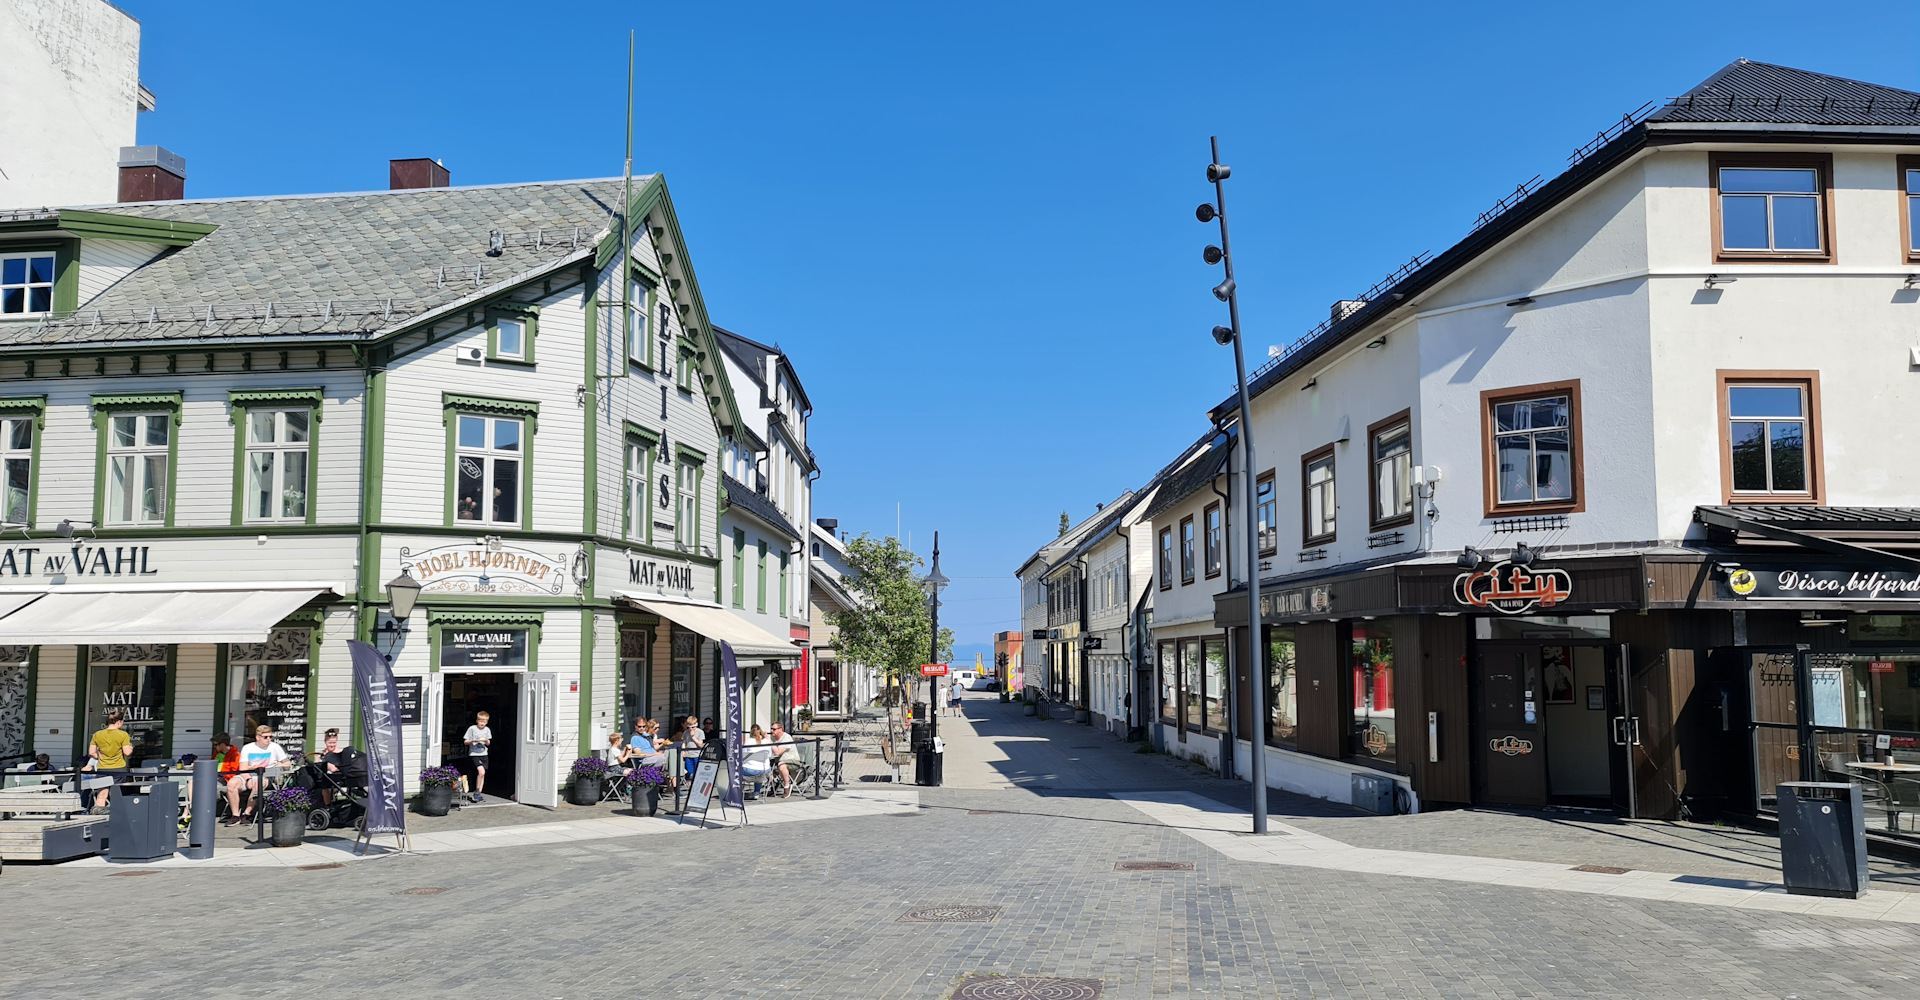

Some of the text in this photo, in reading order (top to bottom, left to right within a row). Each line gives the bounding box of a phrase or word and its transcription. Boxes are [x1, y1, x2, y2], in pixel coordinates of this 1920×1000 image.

[657, 302, 672, 511] ELIAS
[460, 458, 481, 478] OPEN
[43, 556, 66, 574] AV
[71, 546, 158, 576] VAHL
[415, 550, 551, 580] HOEL-HJØRNET
[629, 558, 695, 592] MAT AV VAHL
[1463, 566, 1569, 608] City
[473, 584, 497, 593] 1892
[453, 633, 478, 643] MAT
[485, 633, 514, 643] VAHL
[103, 691, 136, 705] MAT
[1494, 739, 1530, 755] City
